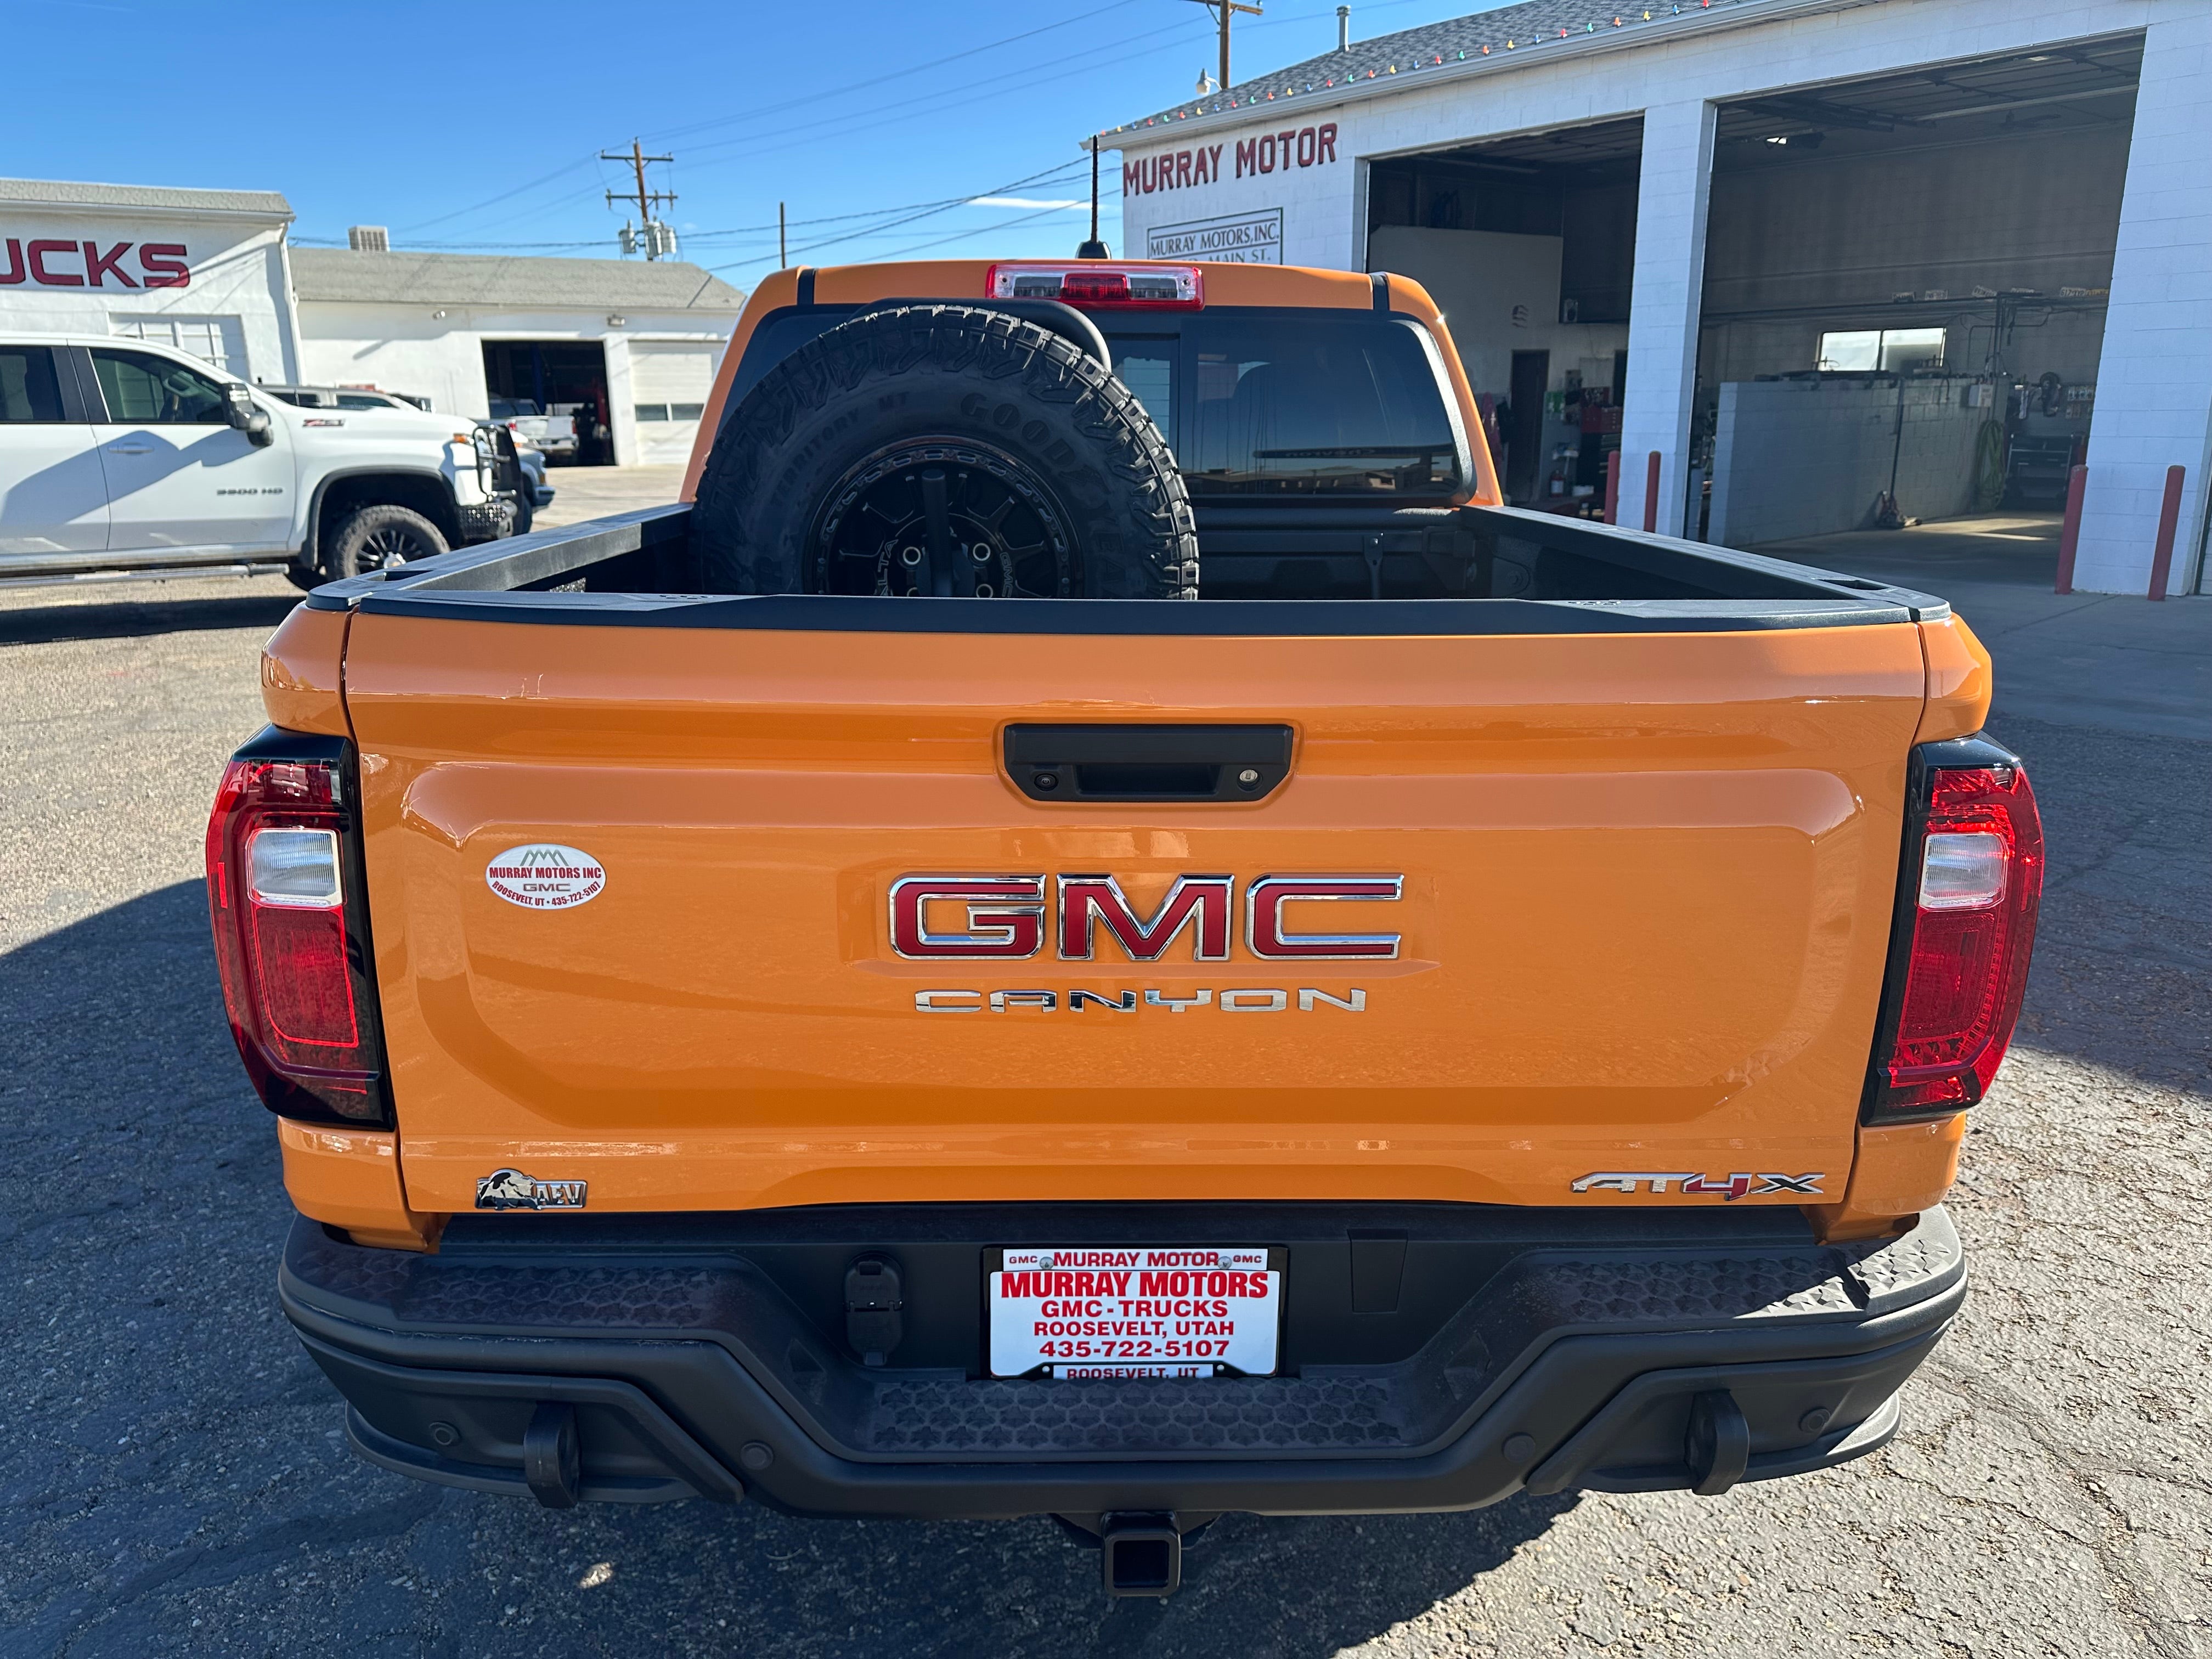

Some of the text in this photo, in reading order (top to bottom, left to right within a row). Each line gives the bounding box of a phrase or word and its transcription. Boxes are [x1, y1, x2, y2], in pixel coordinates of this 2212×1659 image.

[1123, 122, 1338, 197] MURRAY MOTOR
[1150, 234, 1196, 256] MURRAY
[1000, 552, 1014, 597] GMC
[489, 867, 602, 878] MURRAY MOTORS INC
[492, 881, 533, 905] ROOSEVELT,
[551, 881, 601, 906] 435-722-5107
[523, 883, 571, 891] GMC
[888, 872, 1404, 961] GMC
[913, 988, 1366, 1013] CANYON
[537, 1183, 582, 1206] AEV
[1572, 1172, 1826, 1201] AT4X
[1009, 1252, 1263, 1267] GMC MURRAY MOTOR GMC
[1001, 1272, 1268, 1298] MURRAY MOTORS
[1034, 1321, 1234, 1339] ROOSEVELT, UTAH
[1040, 1340, 1229, 1358] 435-722-5107
[1066, 1367, 1199, 1379] ROOSEVELT, UT
